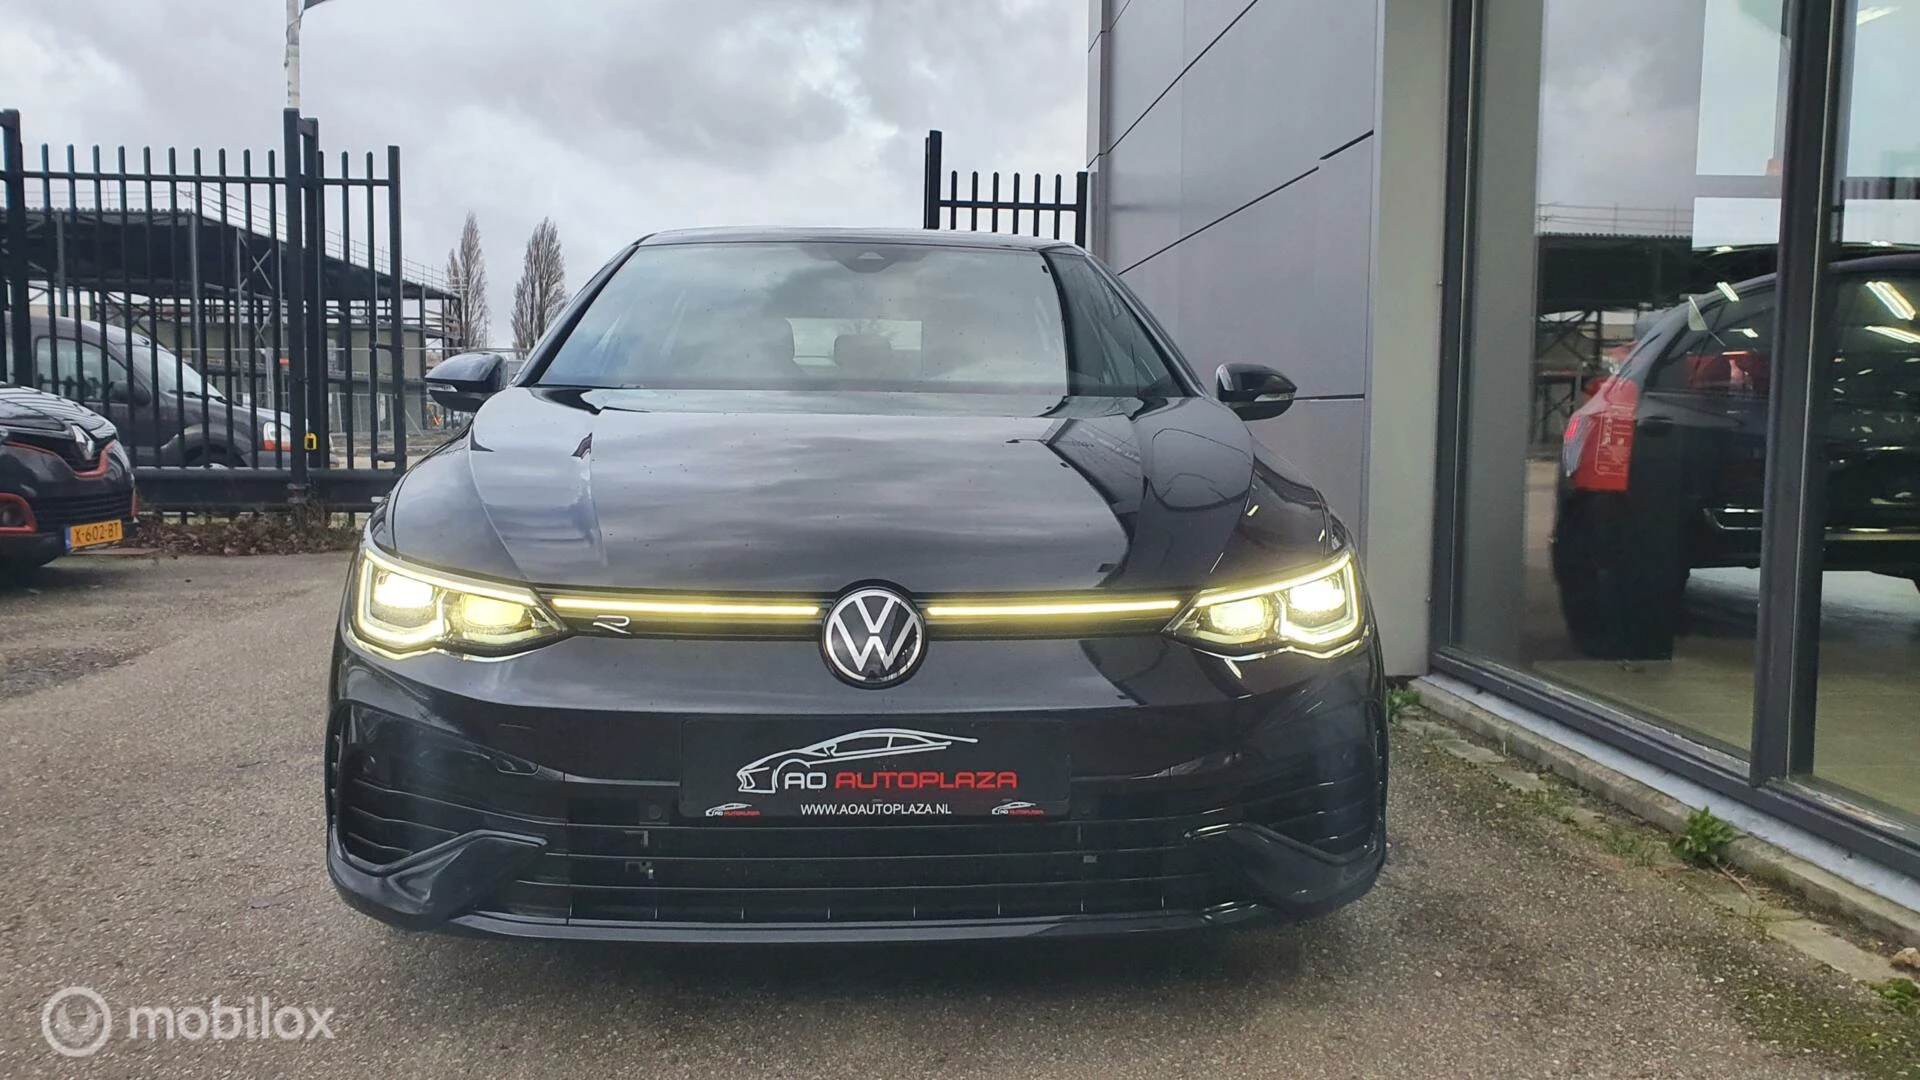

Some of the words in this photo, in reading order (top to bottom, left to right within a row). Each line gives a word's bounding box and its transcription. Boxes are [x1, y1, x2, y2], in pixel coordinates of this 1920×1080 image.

[784, 772, 827, 789] AO
[835, 771, 1018, 789] AUTOPLAZA
[800, 803, 952, 815] WWW.AOAUTOPLAZA.NL
